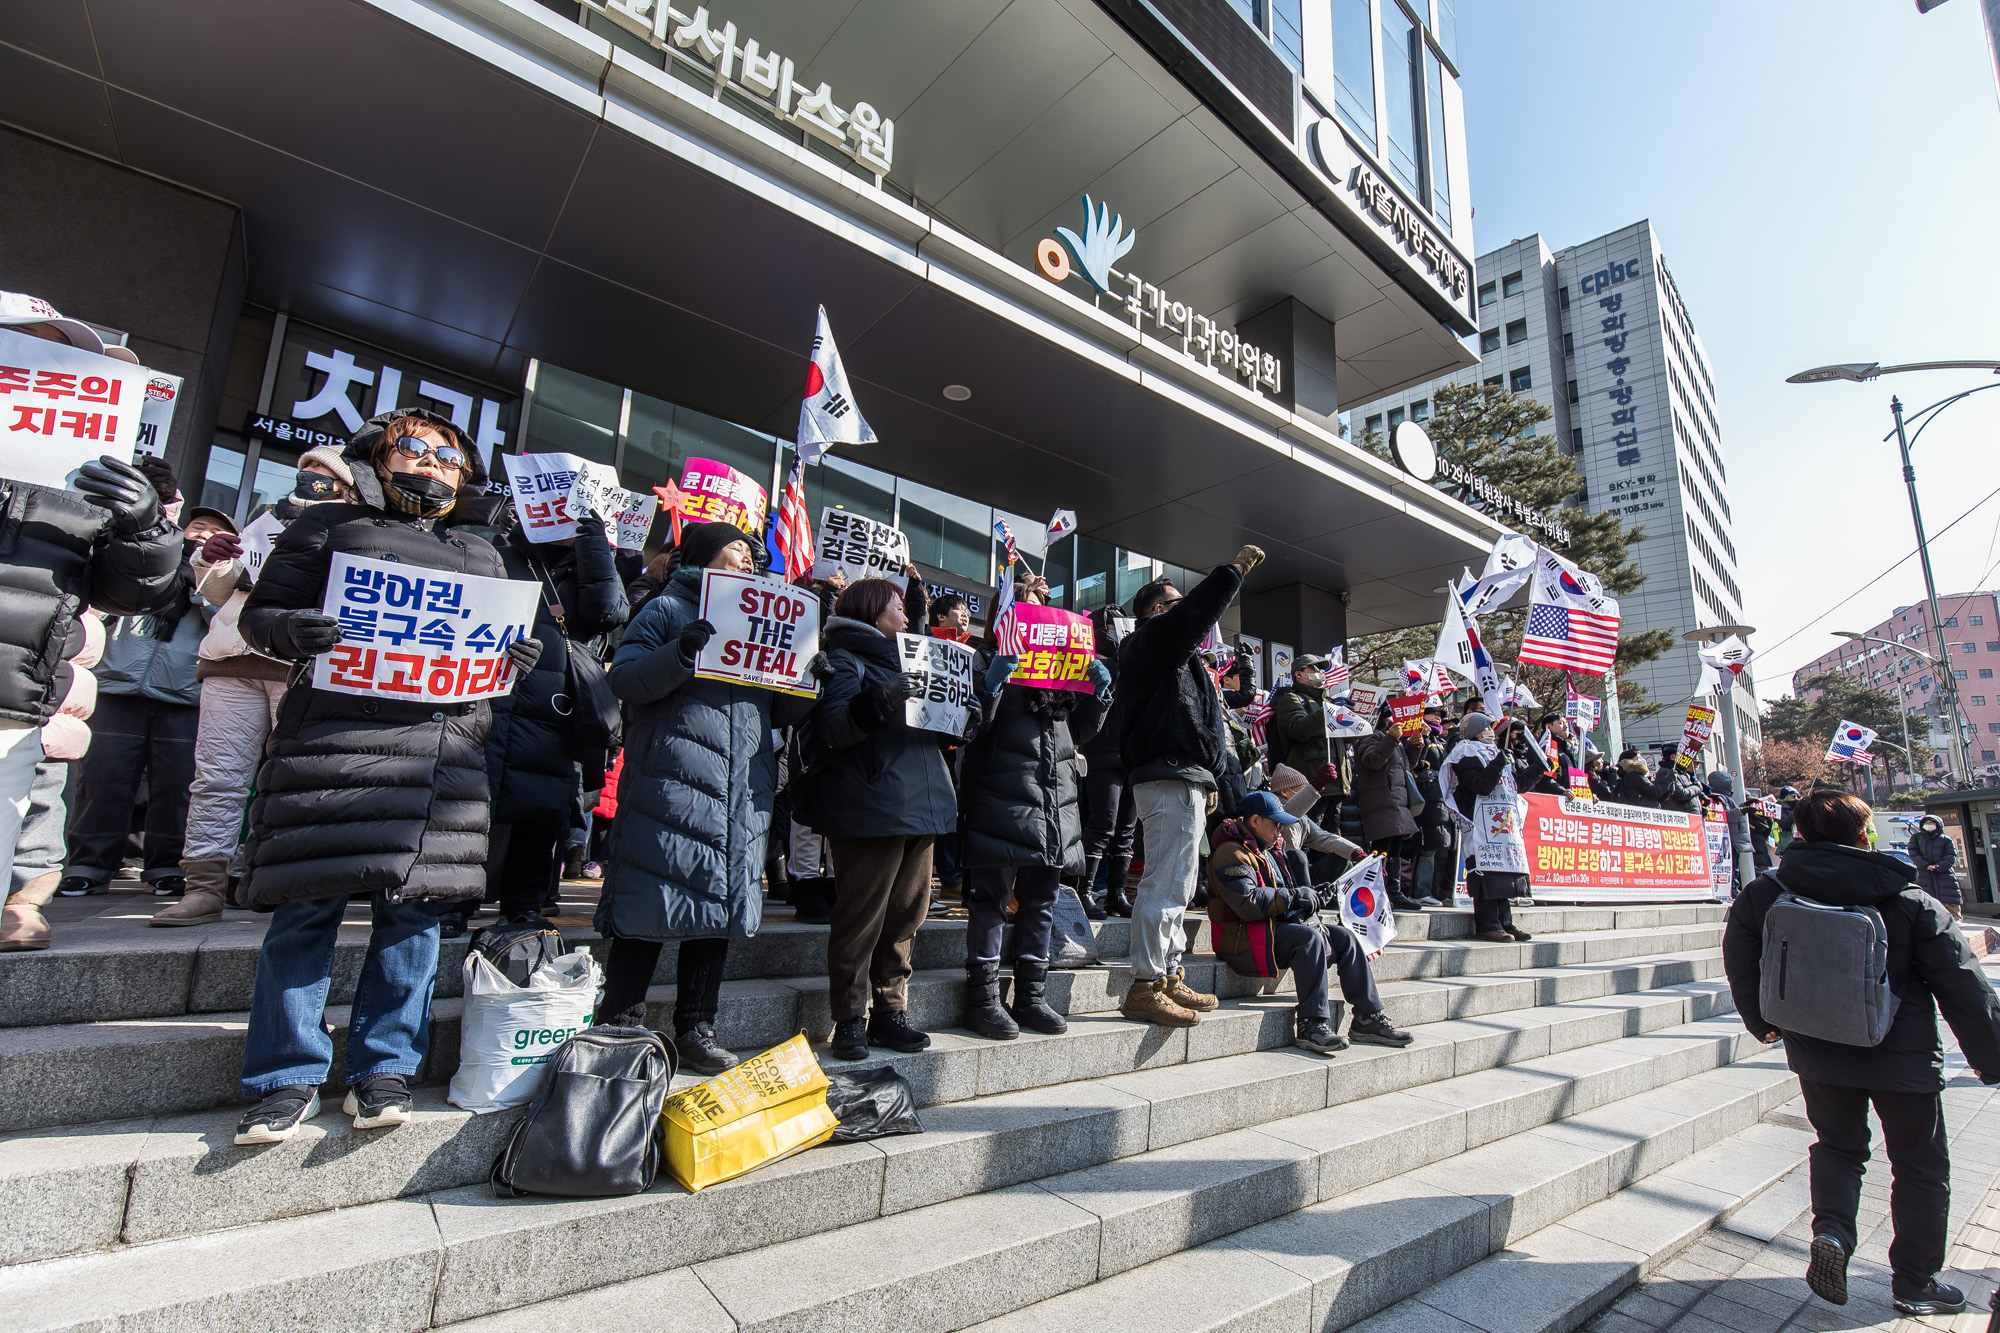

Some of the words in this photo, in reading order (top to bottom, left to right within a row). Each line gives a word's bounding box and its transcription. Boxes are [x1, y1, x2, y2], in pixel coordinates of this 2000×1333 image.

[1350, 162, 1467, 301] 서울지방국세청
[1580, 257, 1640, 295] cpbc
[1123, 272, 1281, 398] 국가인권위원회
[147, 388, 171, 400] STEAL
[8, 405, 118, 443] 지켜!
[682, 471, 702, 490] 윤
[344, 566, 471, 619] 방어권,
[739, 587, 805, 624] STOP
[336, 606, 456, 651] 불구속
[748, 615, 795, 650] THE
[1029, 623, 1068, 646] 대통령
[1070, 622, 1095, 650] 인권
[328, 644, 513, 697] 권고하라!
[720, 640, 798, 678] STEAL
[743, 673, 760, 683] SAVE
[1539, 817, 1589, 844] 인권위는
[1591, 822, 1623, 846] 윤석열
[1624, 826, 1662, 849] 대통령의
[1537, 845, 1575, 870] 방어권
[1578, 848, 1621, 872] 보장하고
[1624, 851, 1654, 874] 불구속
[1656, 852, 1674, 874] 수사
[751, 1058, 777, 1096] CLEAN
[764, 1058, 789, 1092] LOVE
[779, 1063, 798, 1088] AND
[724, 1082, 747, 1107] SAVE
[680, 1102, 705, 1124] LIFE!
